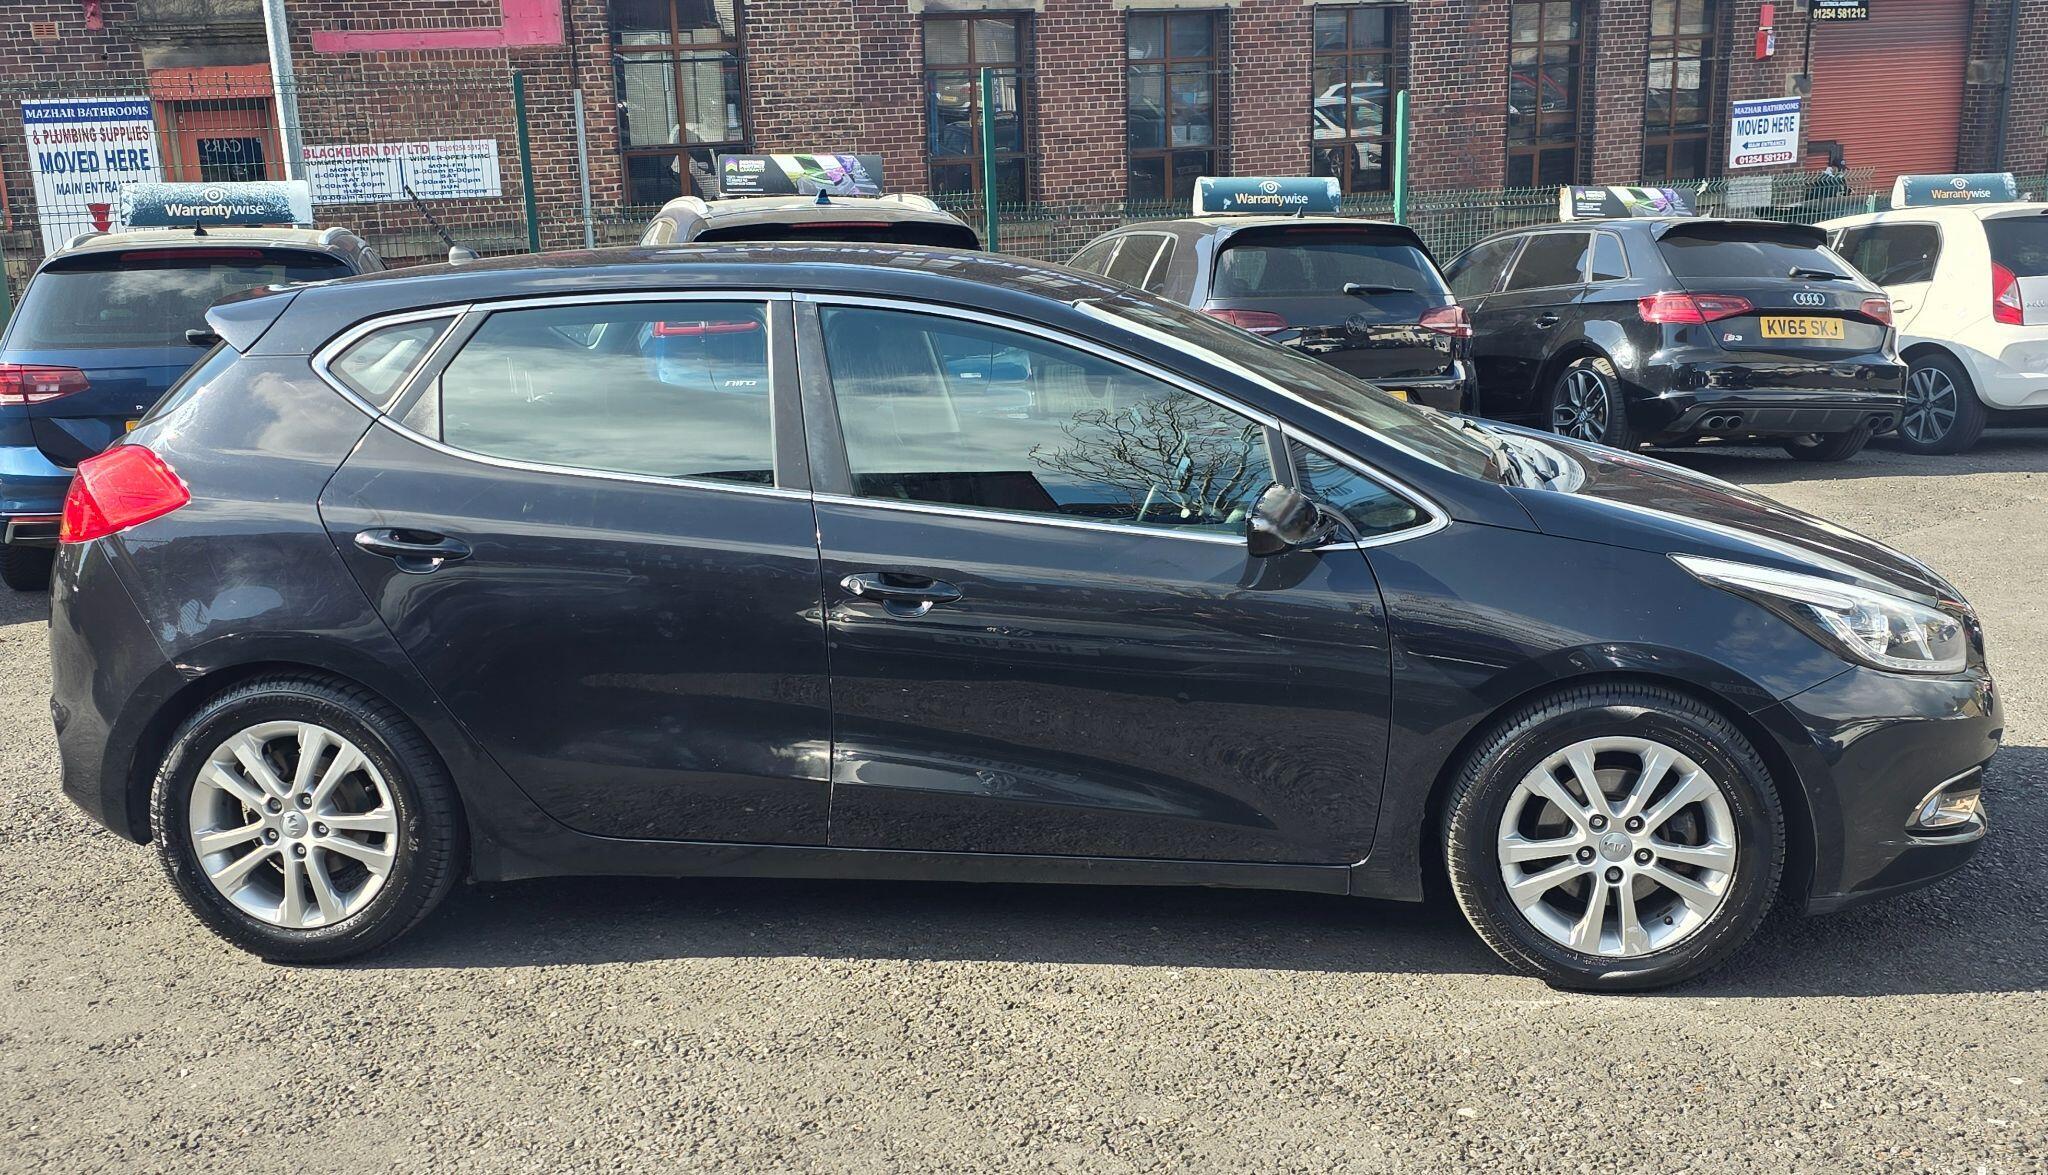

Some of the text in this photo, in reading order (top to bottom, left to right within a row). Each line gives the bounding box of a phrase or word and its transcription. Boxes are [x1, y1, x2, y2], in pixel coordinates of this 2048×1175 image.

[1813, 7, 1867, 19] 01254 581212
[25, 105, 149, 119] MAZHAR BATHROOMS
[1734, 102, 1799, 115] MAZHAR BATHROOMS
[1736, 116, 1795, 136] MOVED HERE
[33, 125, 149, 145] & PLUMBING SUPPLIES
[303, 144, 429, 159] BLACKBURN DIY LTD
[38, 148, 151, 174] MOVED HERE
[1739, 155, 1763, 165] 01254
[56, 182, 82, 196] MAIN
[1931, 188, 1991, 200] Warrantywise
[1235, 192, 1309, 206] Warrantywise
[164, 203, 265, 220] Warrantywise
[1766, 319, 1838, 336] KV65 SKJ
